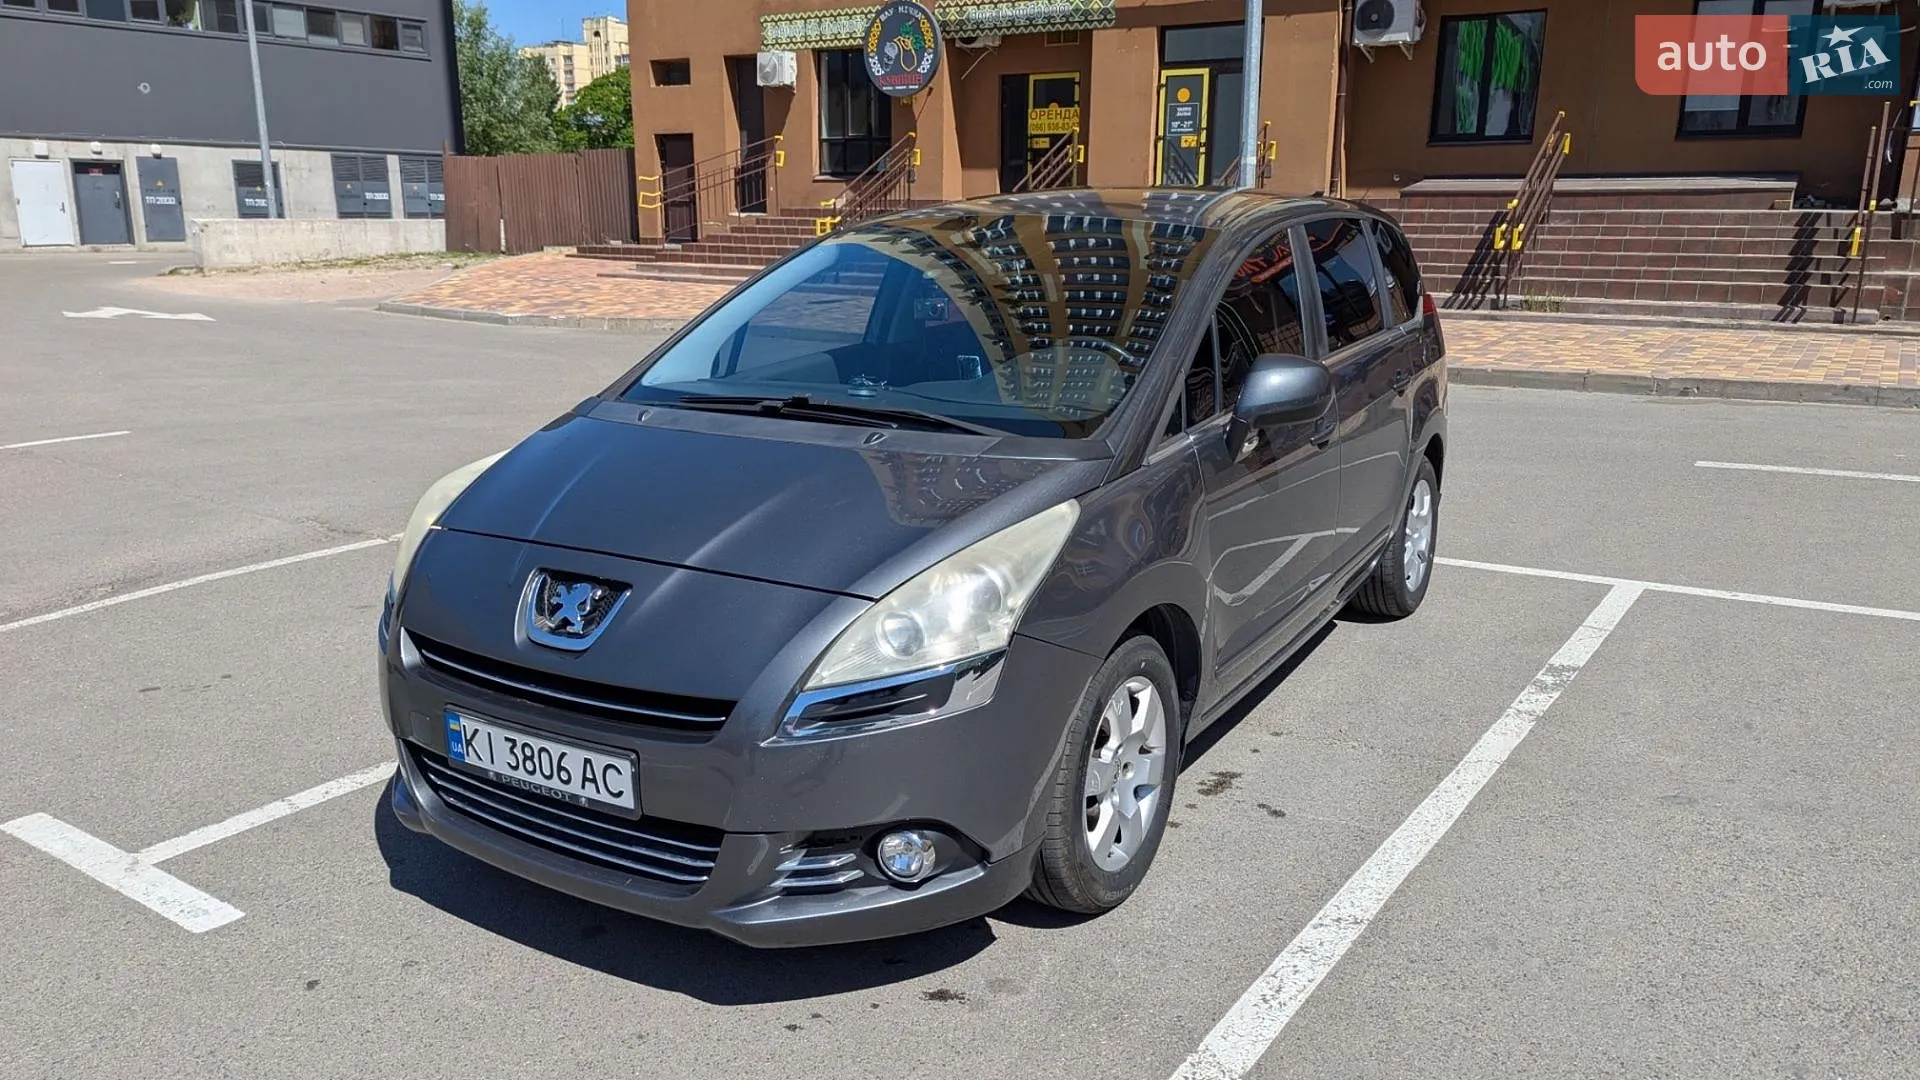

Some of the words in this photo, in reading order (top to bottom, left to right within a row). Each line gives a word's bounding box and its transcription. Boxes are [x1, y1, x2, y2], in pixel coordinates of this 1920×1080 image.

[1030, 109, 1080, 121] ОРЕНДА
[451, 741, 464, 754] UA
[462, 724, 495, 765] KI
[504, 736, 573, 786] 3806
[580, 757, 625, 799] AC
[501, 775, 571, 802] PEUGEOT
